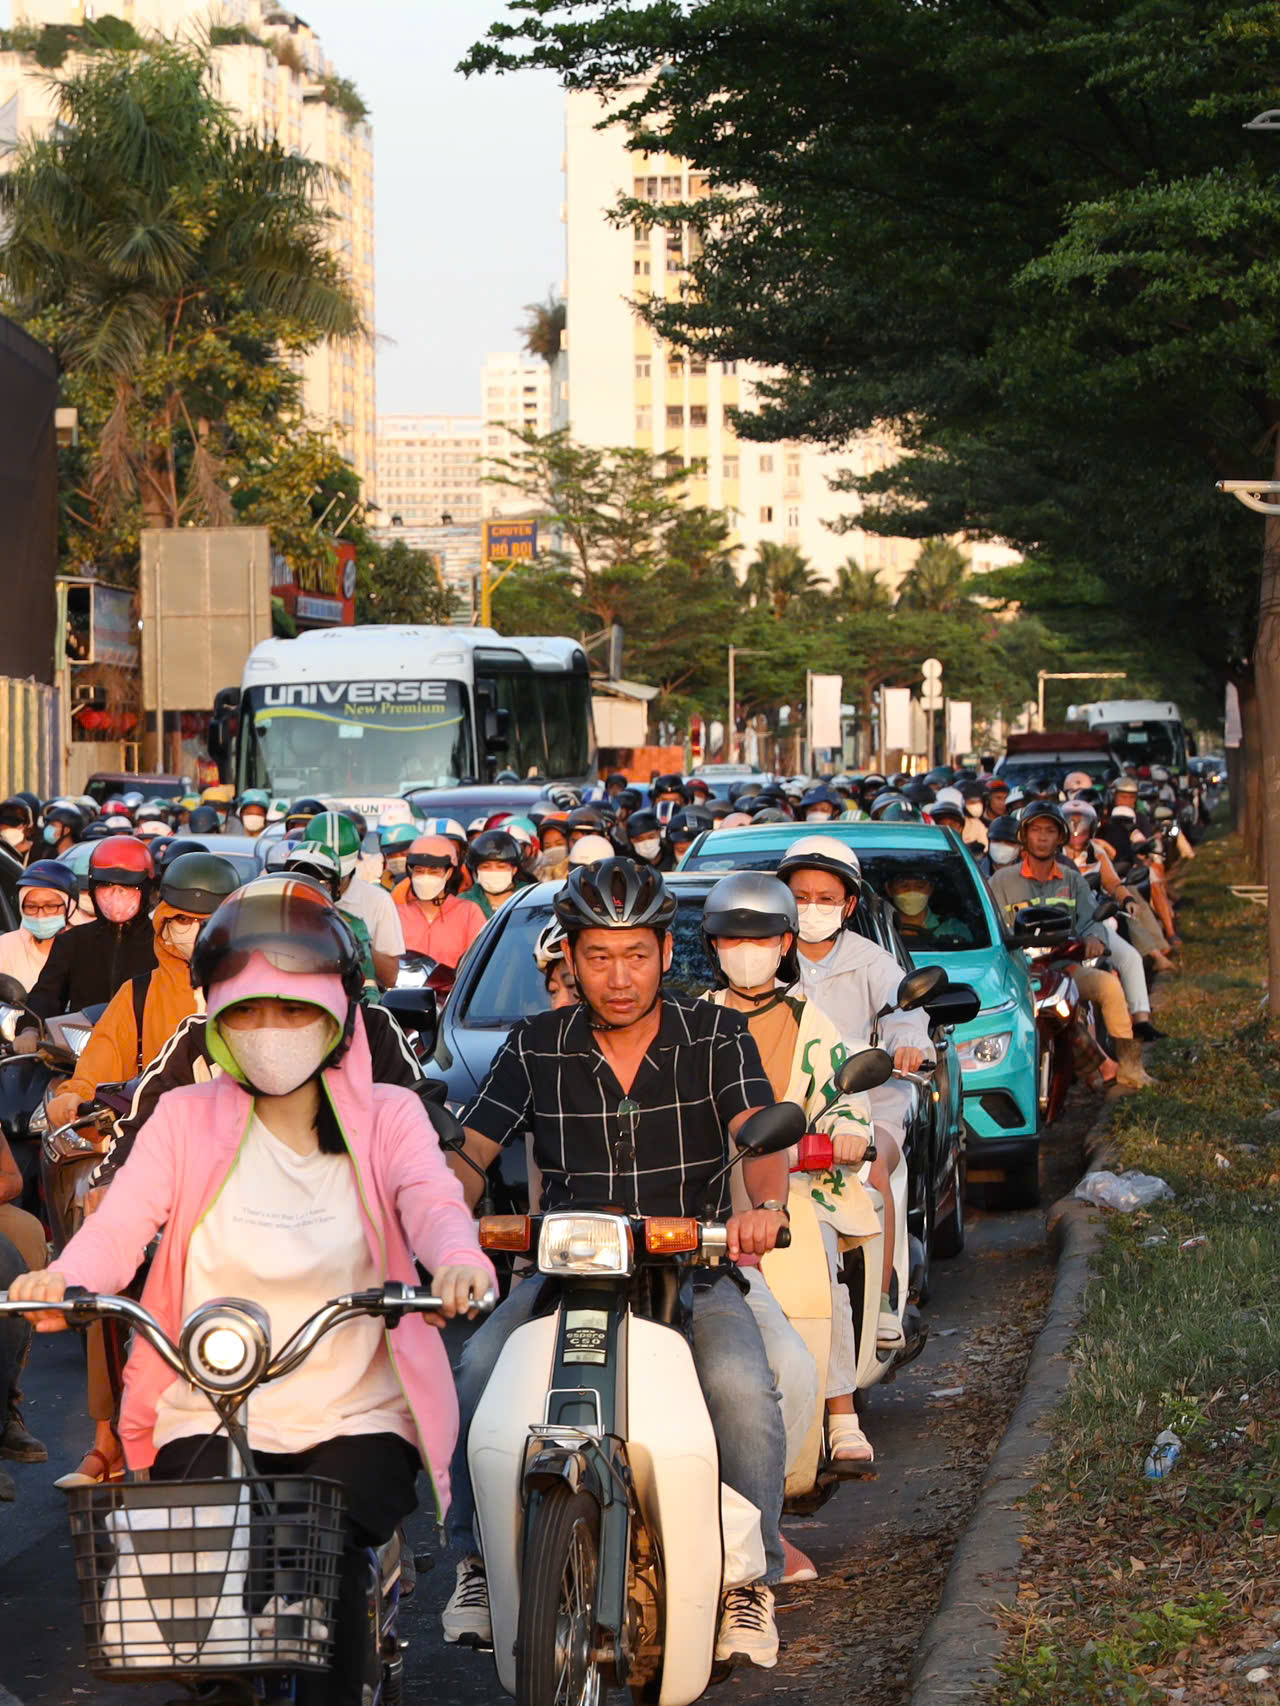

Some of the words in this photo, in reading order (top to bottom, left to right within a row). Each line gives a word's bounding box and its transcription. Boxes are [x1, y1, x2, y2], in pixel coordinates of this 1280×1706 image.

[264, 682, 447, 705] UNIVERSE
[344, 703, 377, 715] New
[381, 702, 445, 714] Premium
